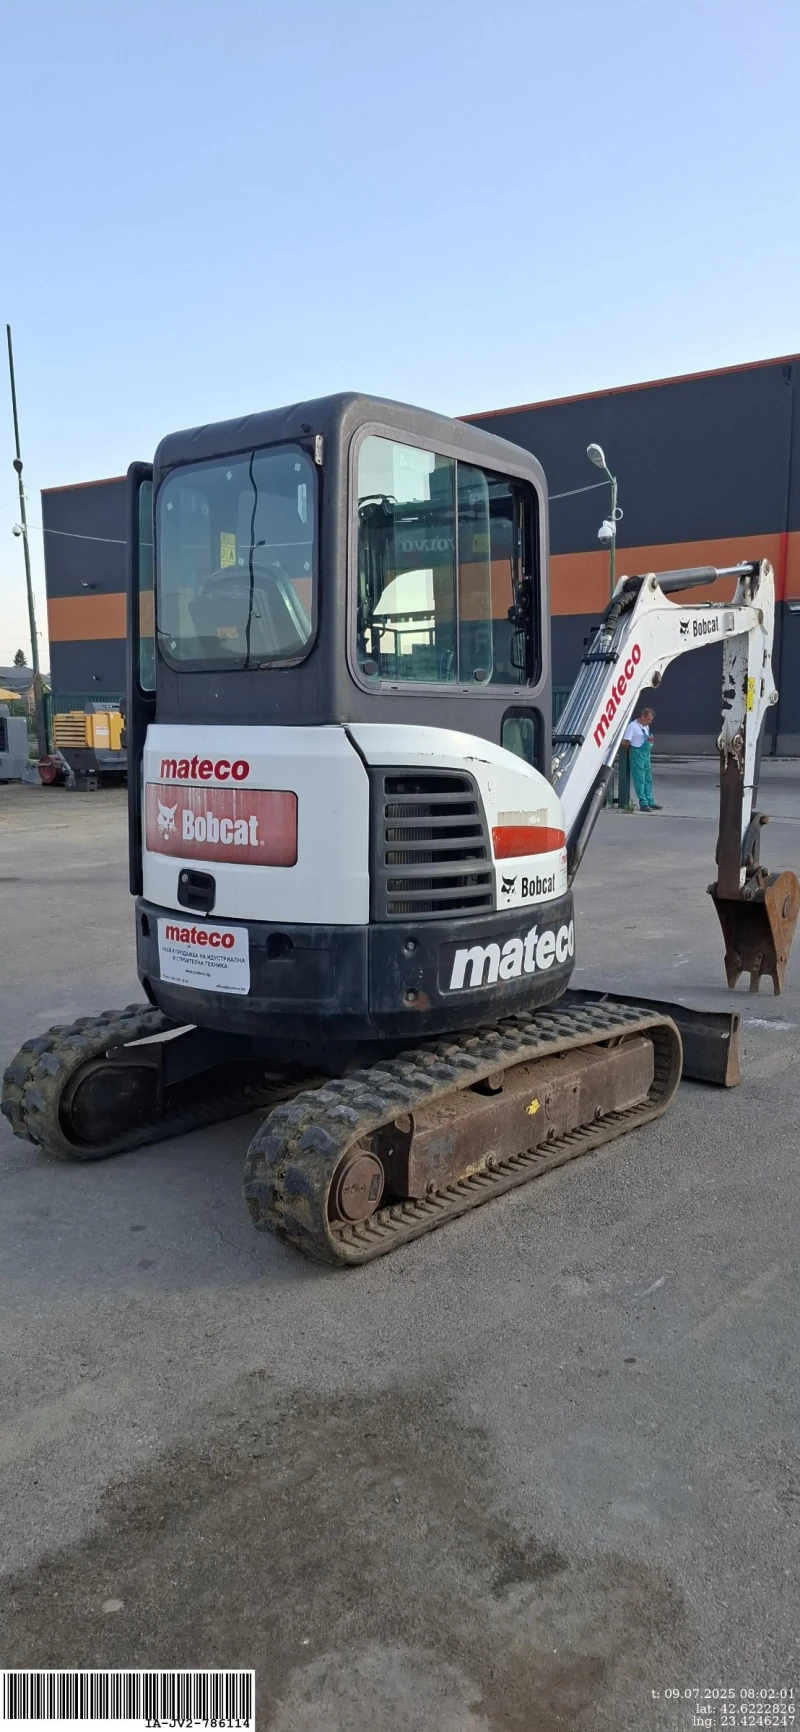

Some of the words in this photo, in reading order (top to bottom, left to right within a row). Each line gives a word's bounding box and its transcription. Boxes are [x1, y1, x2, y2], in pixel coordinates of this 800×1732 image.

[693, 616, 719, 637] Bobcat
[593, 644, 642, 748] mateco
[160, 755, 250, 780] mateco
[182, 810, 258, 846] Bobcat
[521, 873, 555, 897] Bobcat
[165, 925, 235, 948] mateco
[450, 920, 575, 989] mateco
